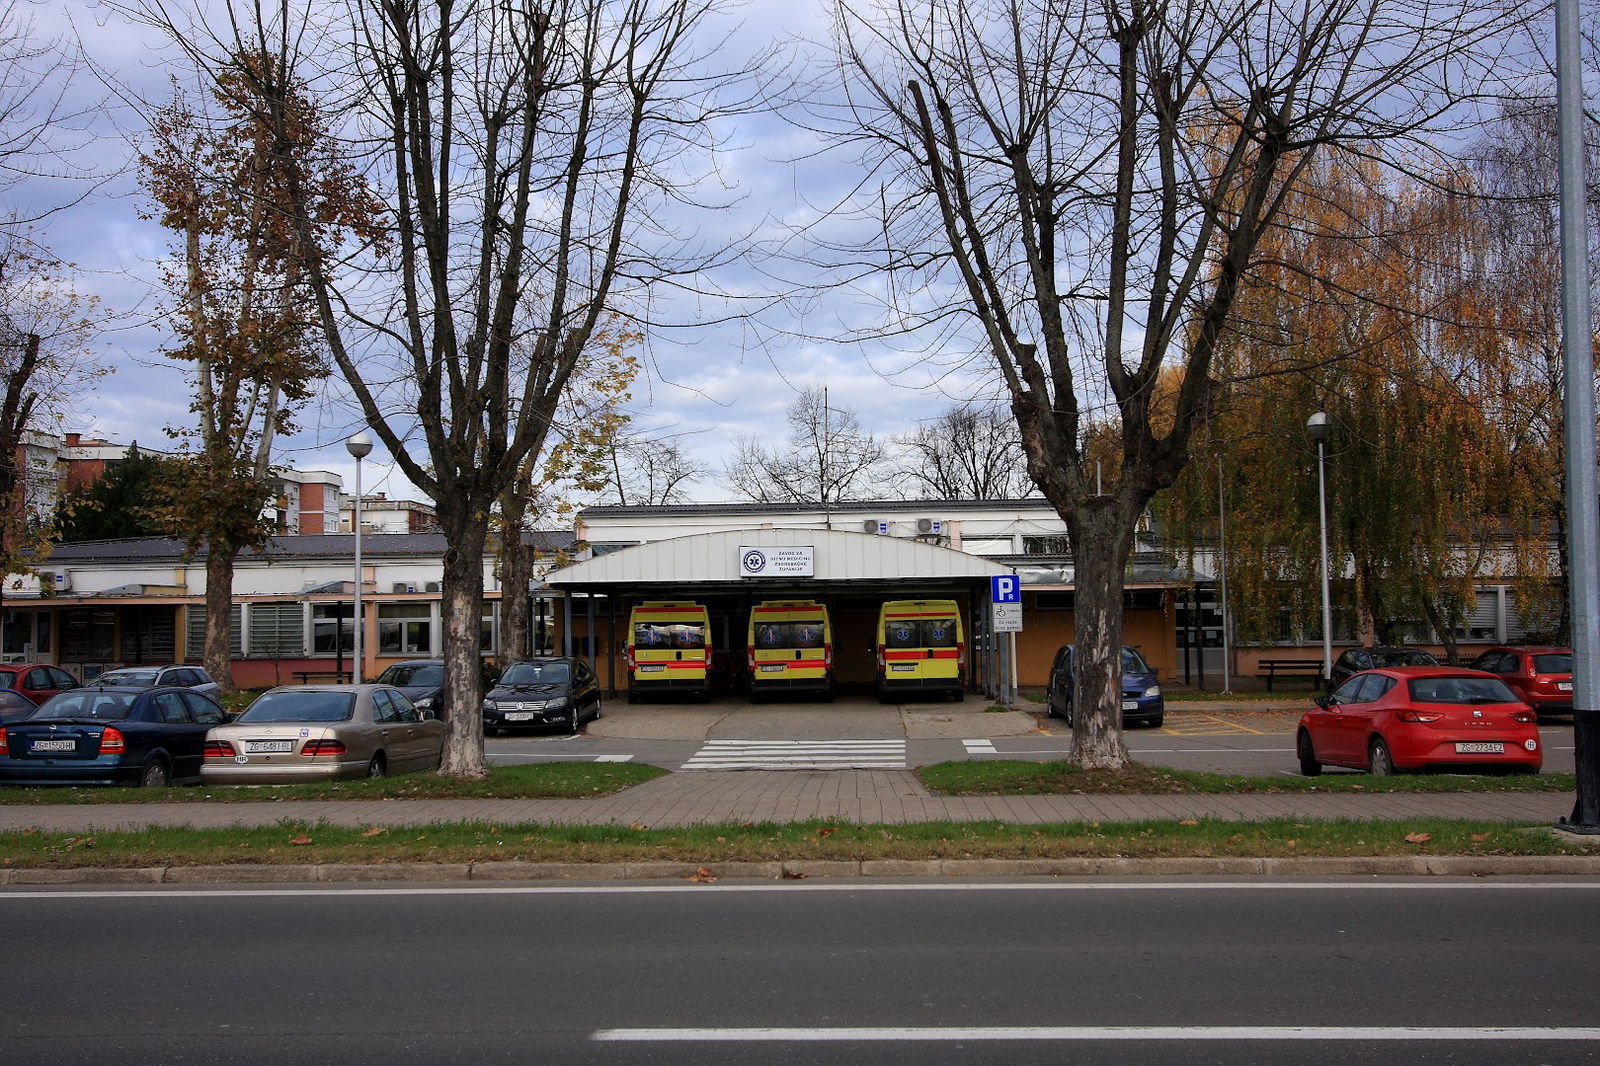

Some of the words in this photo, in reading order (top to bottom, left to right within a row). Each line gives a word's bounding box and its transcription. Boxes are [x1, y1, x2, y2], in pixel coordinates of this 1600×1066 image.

[998, 577, 1012, 600] P
[250, 742, 259, 750] ZG
[1462, 743, 1471, 752] ZG
